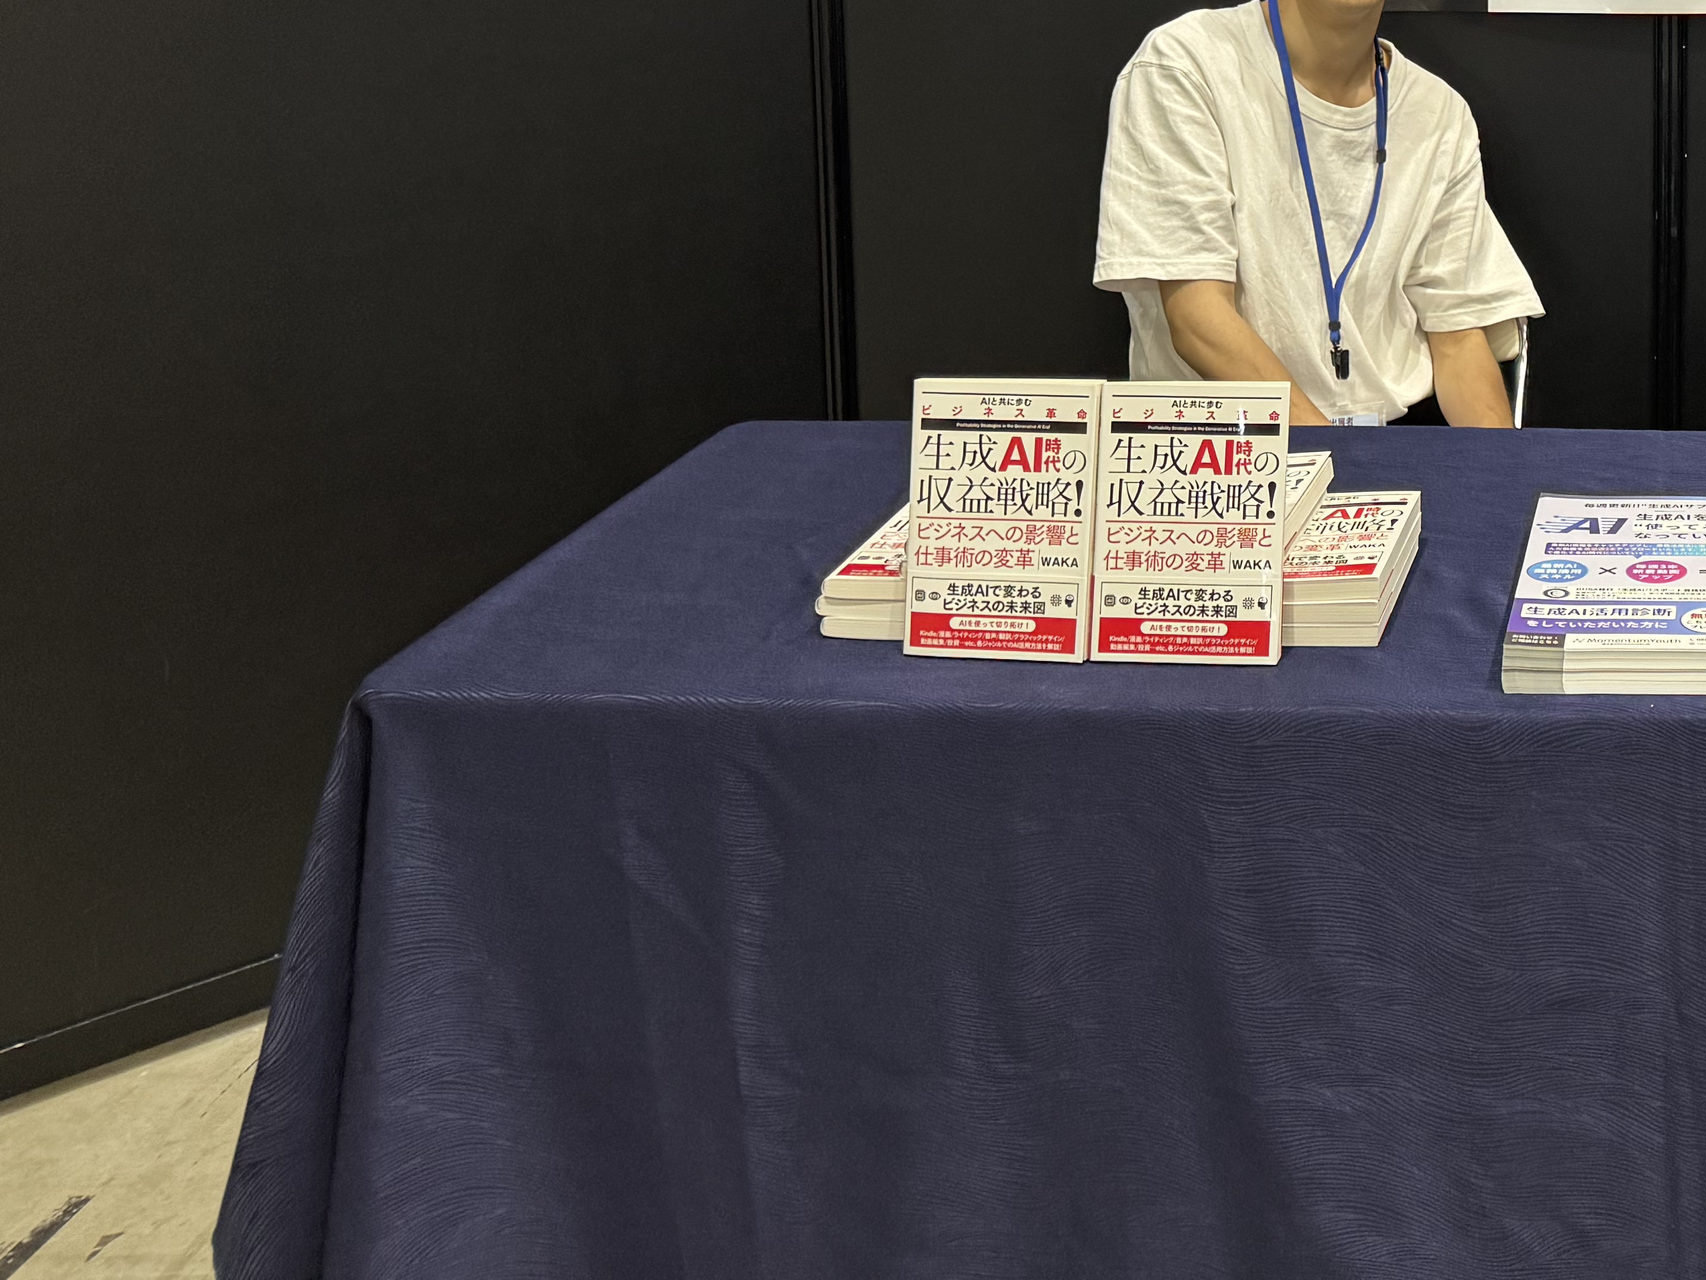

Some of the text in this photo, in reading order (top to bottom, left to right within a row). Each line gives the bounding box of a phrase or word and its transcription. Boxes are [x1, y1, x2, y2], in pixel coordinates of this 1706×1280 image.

[980, 397, 1032, 407] AIと共に歩む
[1171, 400, 1223, 410] AIと共に歩む
[919, 433, 1087, 474] 生成AI時代の
[1109, 435, 1278, 478] 生成AI時代の
[917, 475, 1084, 518] 収益戦略!
[1107, 477, 1276, 522] 収益戦略!
[917, 523, 1079, 546] ビジネスへの影響と
[1107, 525, 1271, 550] ビジネスへの影響と
[914, 545, 1035, 570] 仕事術の変革
[1041, 556, 1078, 568] WAKA
[1105, 548, 1226, 574] 仕事術の変革
[1232, 559, 1270, 571] WAKA
[947, 583, 1042, 599] 生成AIで変わる
[1137, 586, 1233, 603] 生成AIで変わる
[943, 598, 1046, 615] ビジネスの未来図
[1133, 602, 1238, 619] ビジネスの未来図
